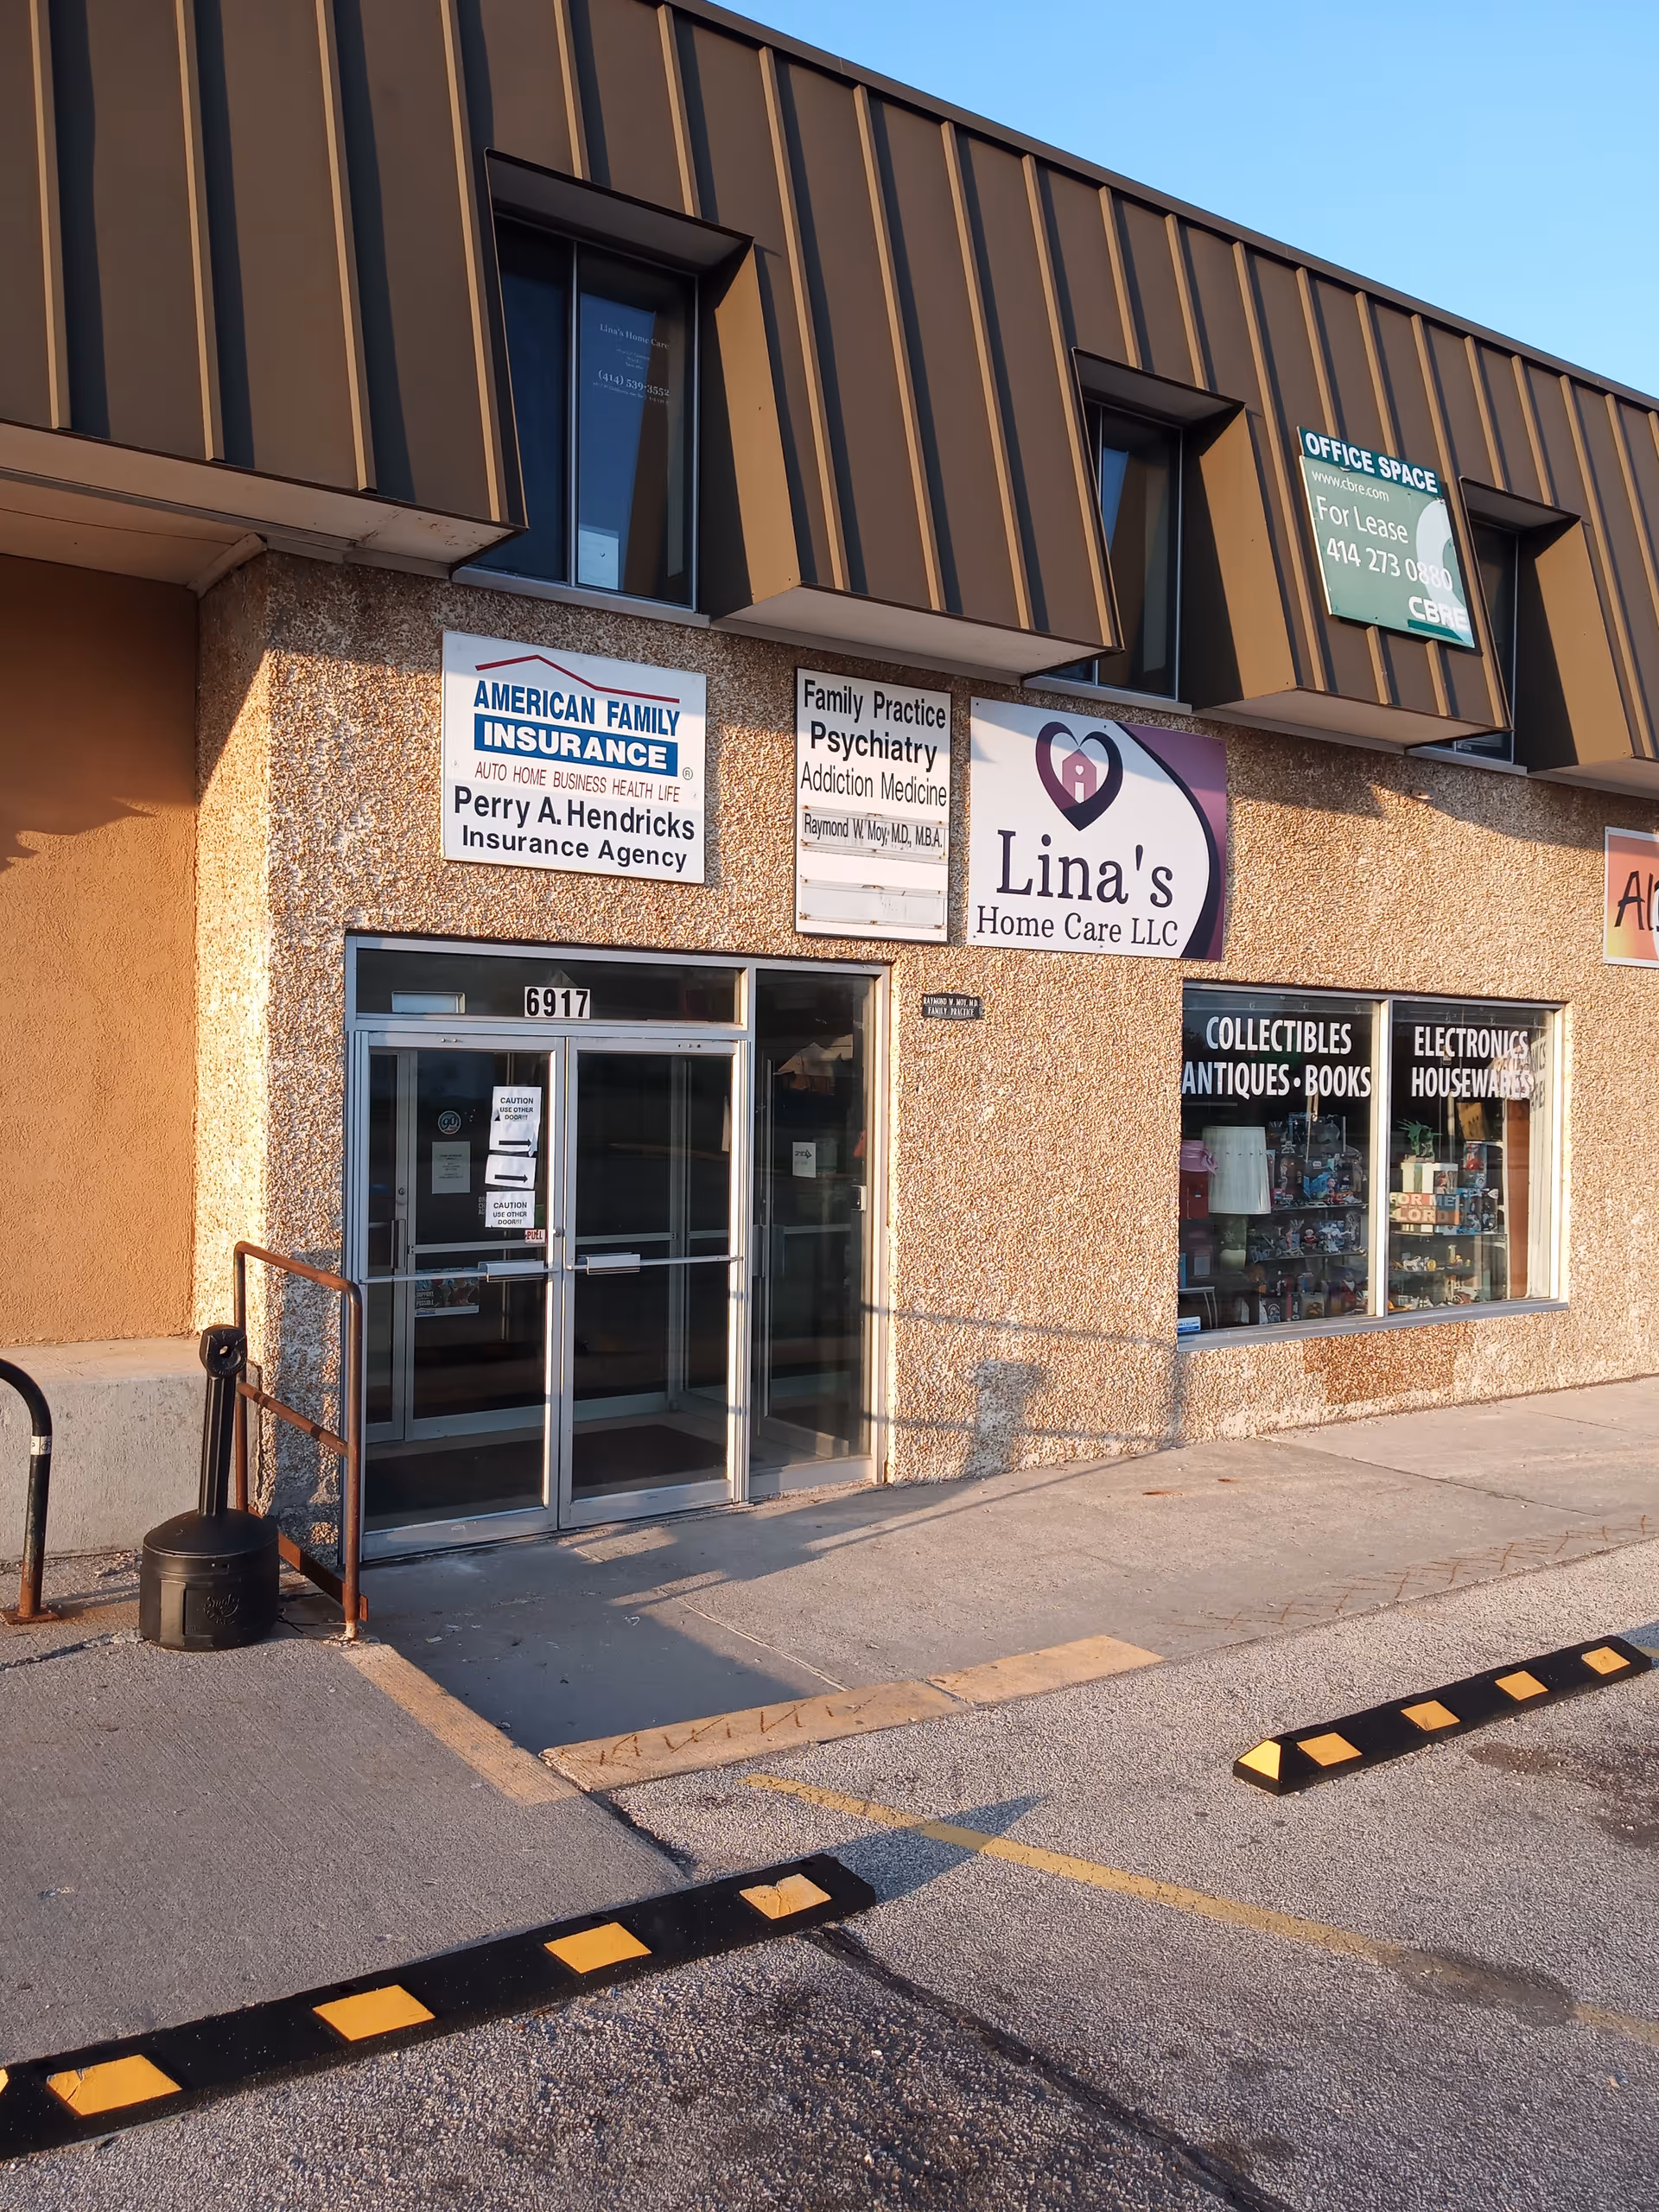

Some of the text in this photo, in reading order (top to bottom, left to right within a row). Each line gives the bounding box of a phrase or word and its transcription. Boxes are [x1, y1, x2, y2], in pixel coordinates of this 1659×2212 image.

[598, 369, 624, 385] (414)
[626, 378, 671, 397] 539-3552
[1305, 432, 1439, 493] OFFICE SPACE
[1312, 469, 1390, 502] www.cbre.com
[1316, 495, 1409, 544] For Lease
[1326, 537, 1453, 592] 414 273 0880
[1408, 596, 1470, 632] CBRE
[474, 679, 681, 736] AMERICAN FAMILY
[804, 678, 946, 728] Family Practice
[483, 721, 668, 771] INSURANCE
[810, 720, 938, 772] Psychiatry
[474, 760, 681, 803] AUTO HOME BUSINESS HEALTH LIFE
[800, 760, 948, 807] Addiction Medicine
[454, 785, 531, 828] Perry
[567, 798, 696, 841] Hendricks
[804, 812, 849, 840] Raymond
[853, 817, 864, 840] W.
[915, 825, 943, 849] M.B.A.
[462, 824, 688, 873] Insurance Agency
[995, 829, 1173, 908] Lina's
[976, 905, 1179, 947] Home Care LLC
[526, 988, 588, 1018] 6917
[923, 996, 948, 1006] RAYMOND
[927, 1007, 975, 1016] FAMILY PRACTICE
[1205, 1015, 1352, 1055] COLLECTIBLES
[1414, 1026, 1529, 1059] ELECTRONICS
[1411, 1066, 1531, 1098] HOUSEWARES
[526, 1230, 543, 1240] PULL
